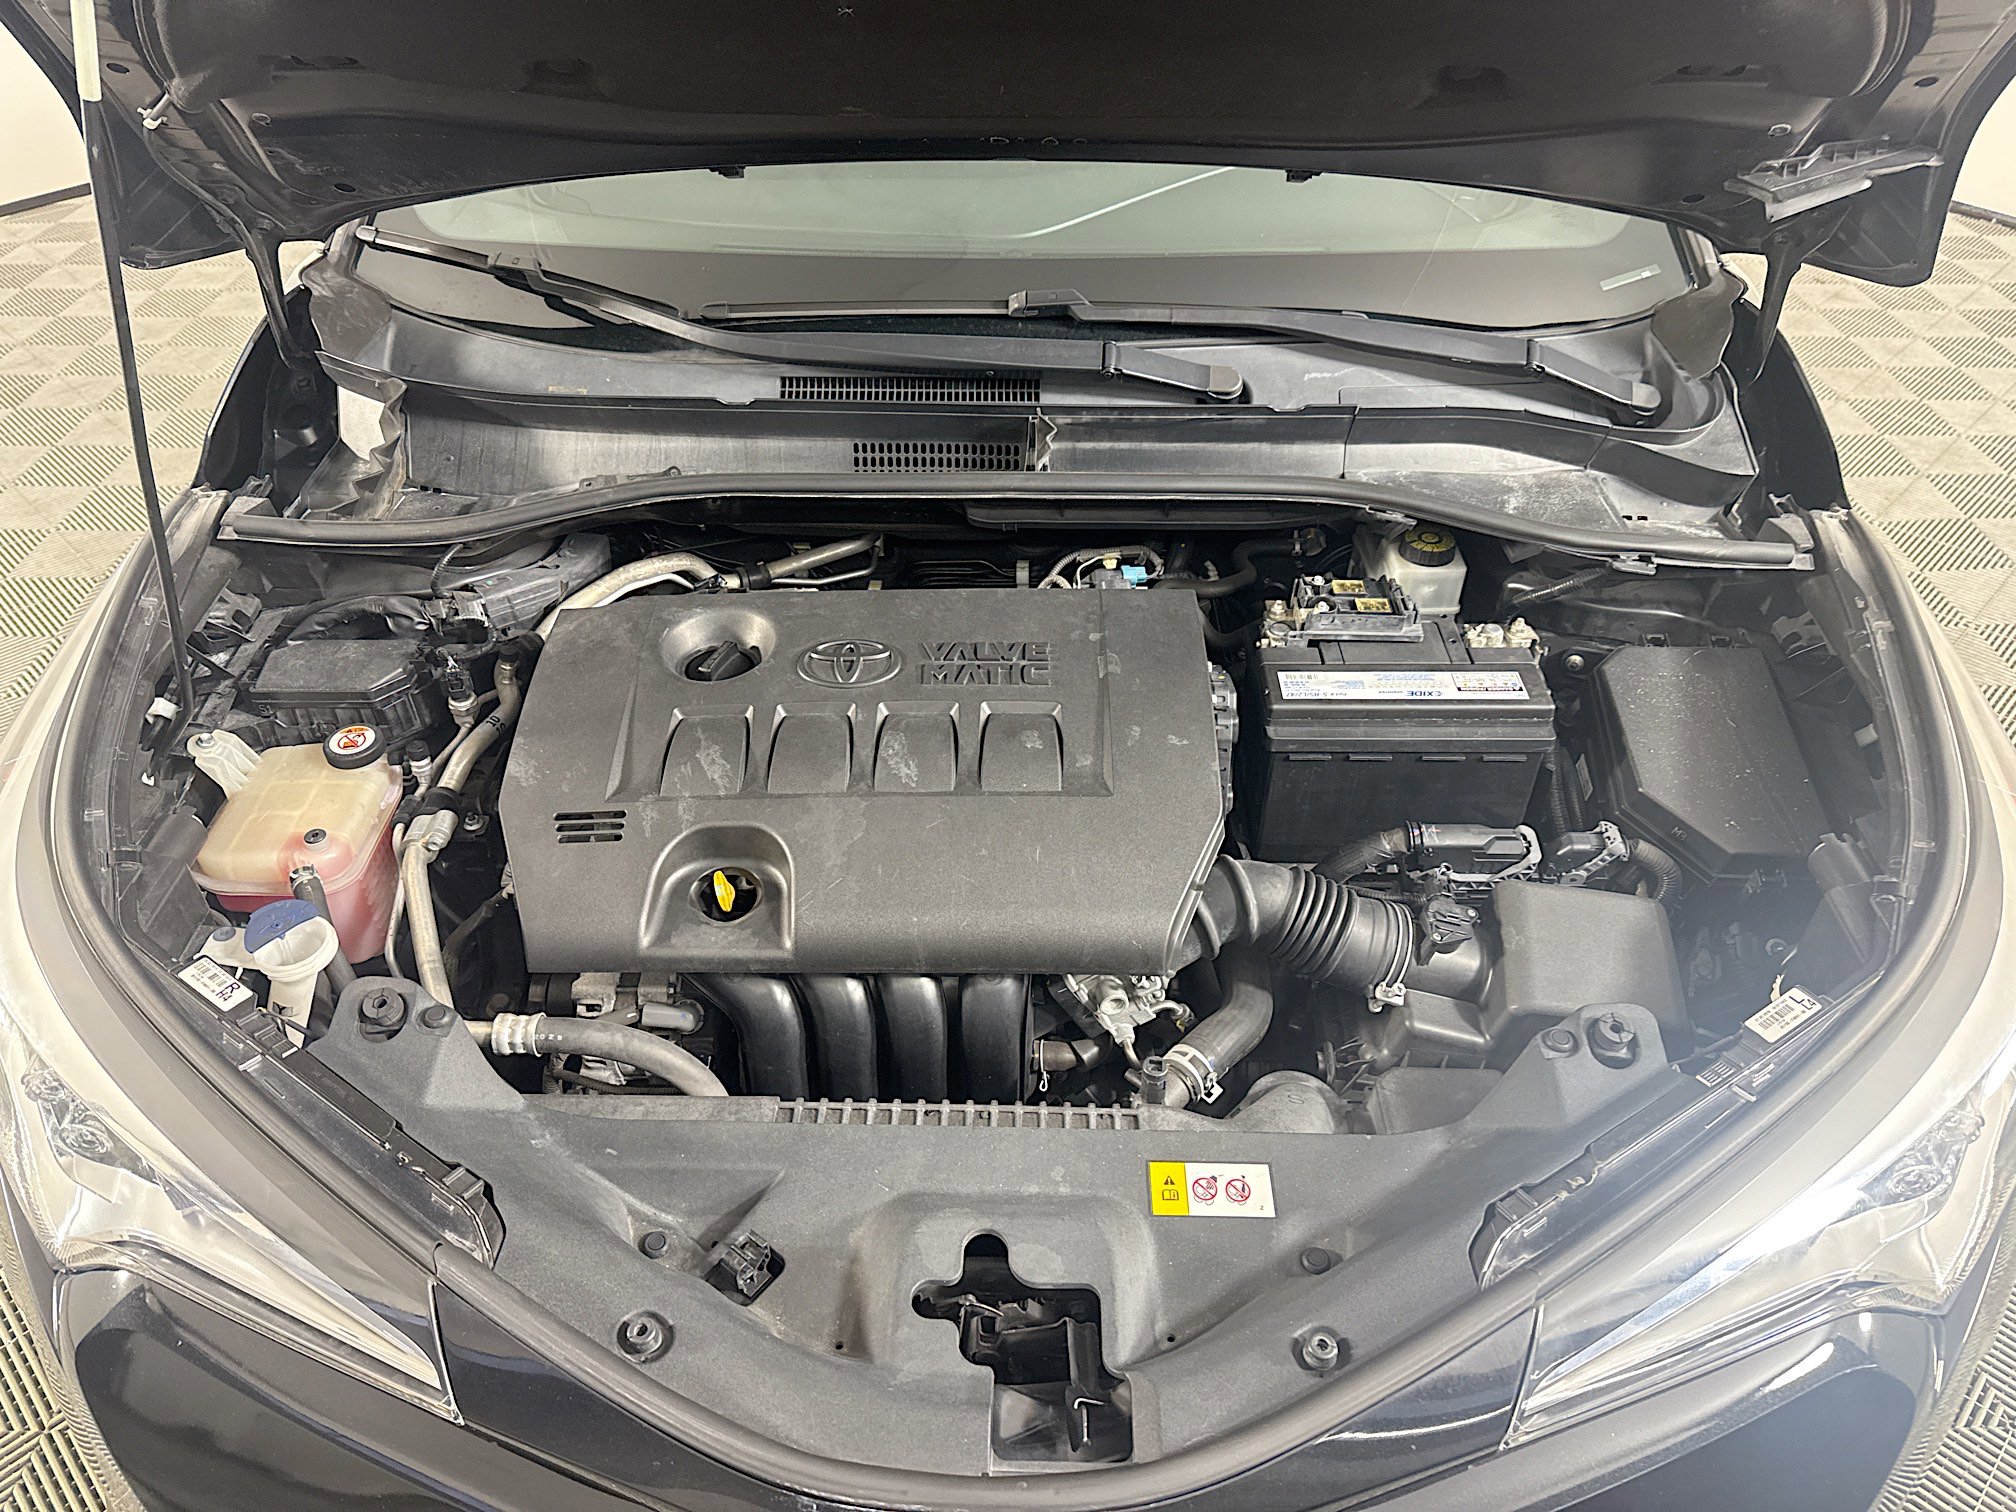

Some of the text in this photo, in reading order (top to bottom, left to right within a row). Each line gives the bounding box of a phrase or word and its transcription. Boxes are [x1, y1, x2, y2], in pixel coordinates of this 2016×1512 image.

[921, 641, 1050, 662] VALVE
[921, 662, 1050, 686] MATIC
[1406, 689, 1444, 697] EXIDE
[224, 981, 241, 994] R
[215, 990, 233, 1002] H4
[1788, 994, 1805, 1004] L
[1801, 998, 1817, 1011] L4
